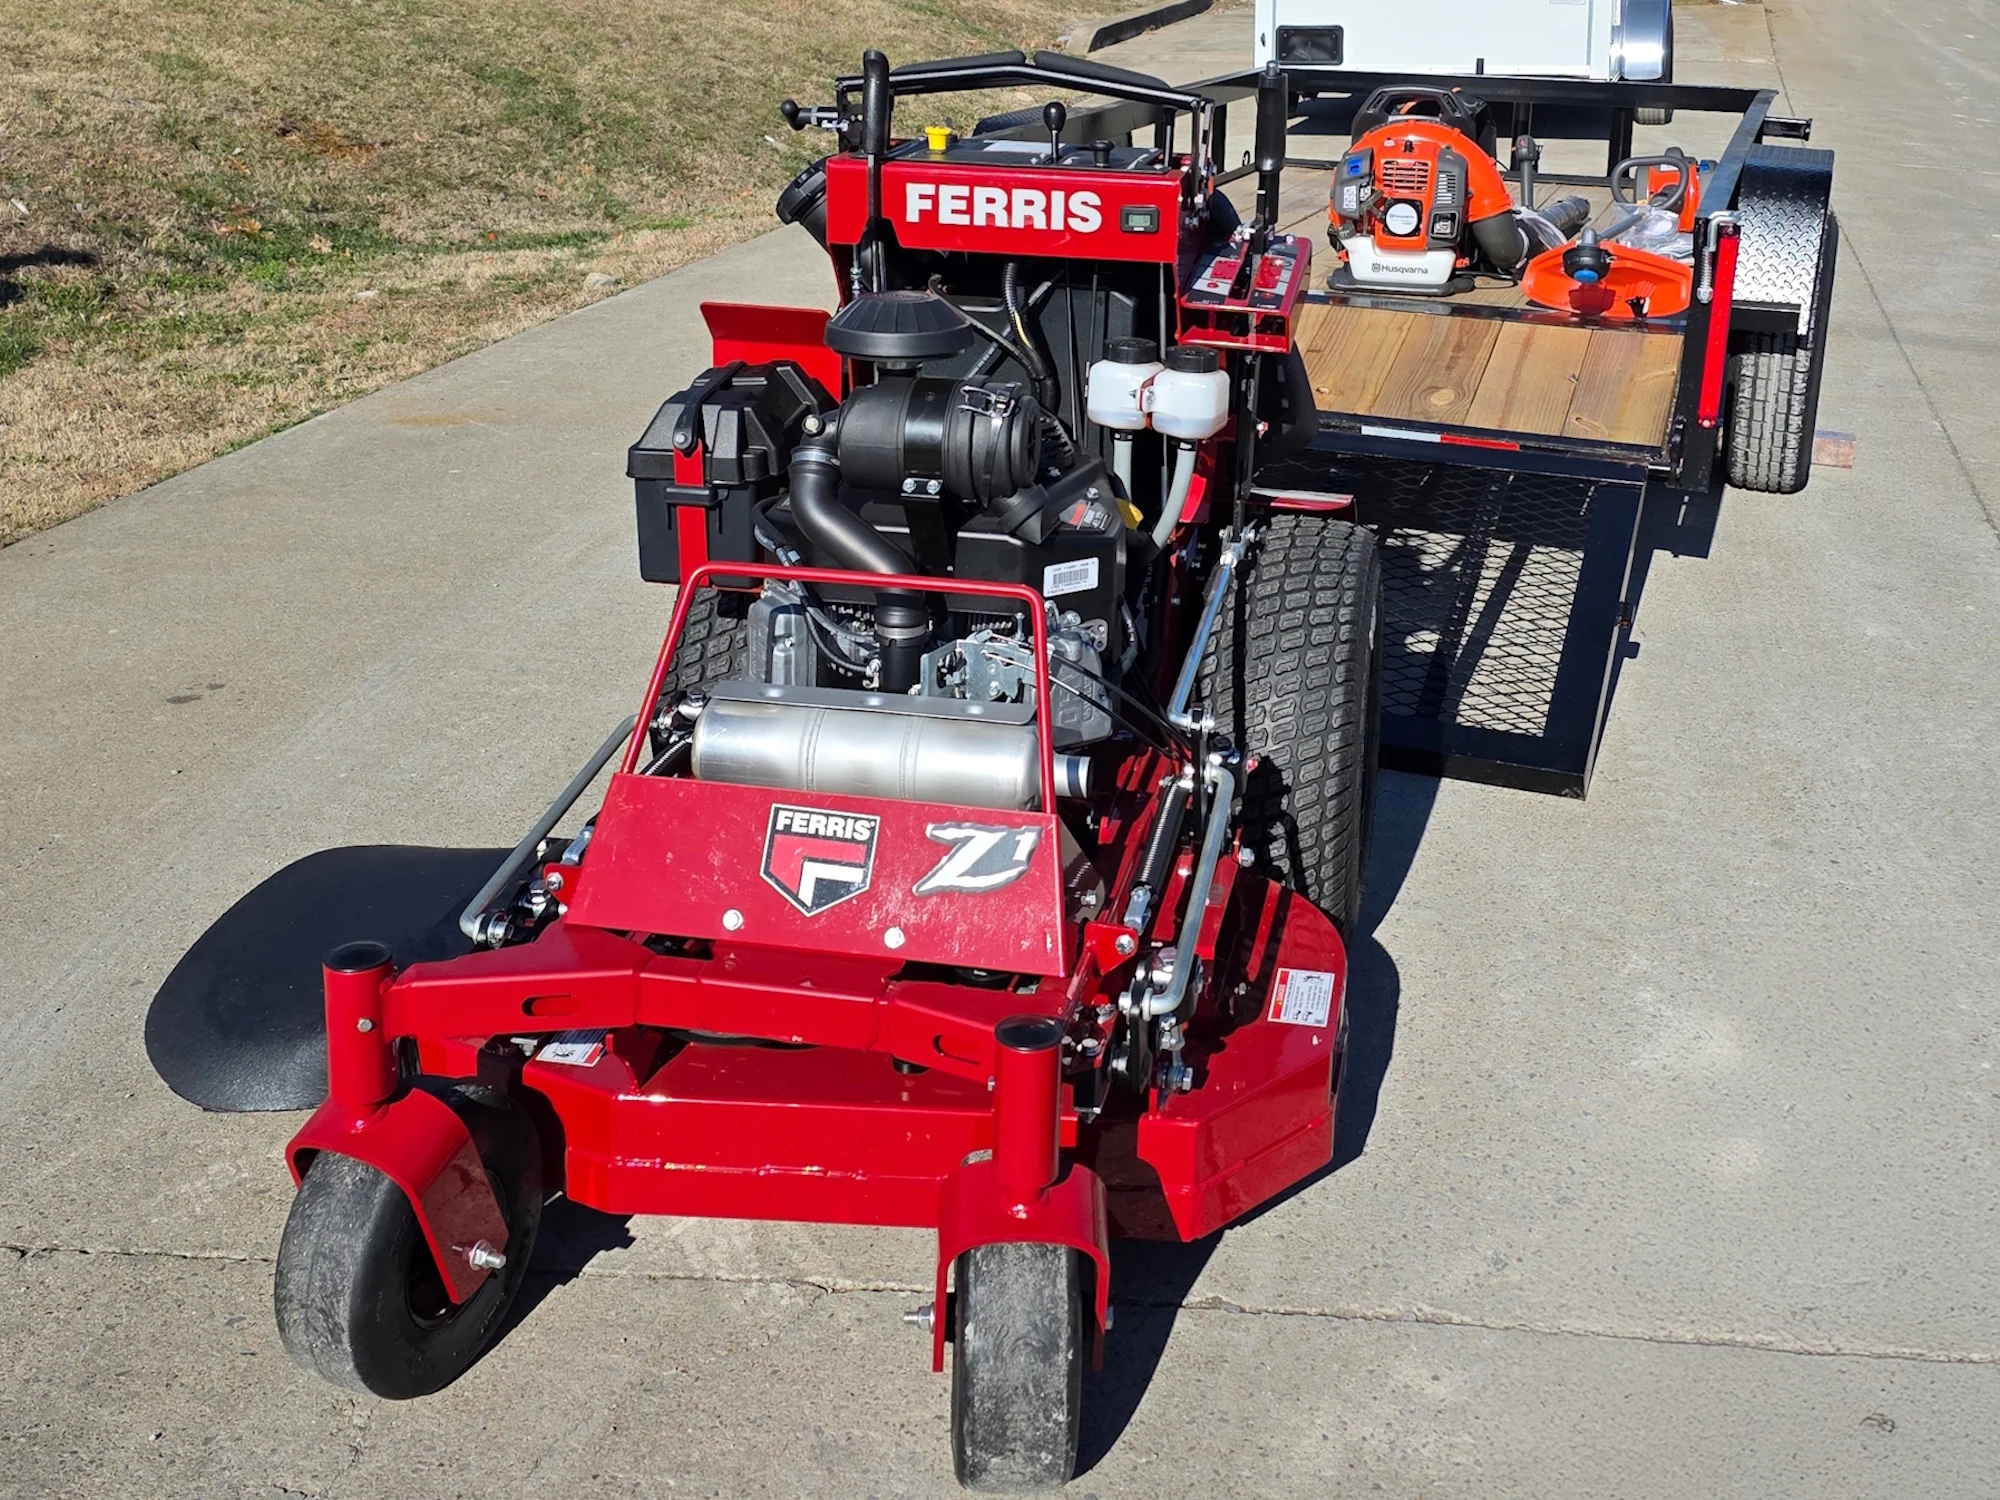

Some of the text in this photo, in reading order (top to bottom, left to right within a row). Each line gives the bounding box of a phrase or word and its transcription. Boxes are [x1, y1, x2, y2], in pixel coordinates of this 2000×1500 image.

[905, 182, 1102, 233] FERRIS
[1381, 263, 1428, 275] Husqvarna
[775, 809, 873, 841] FERRIS
